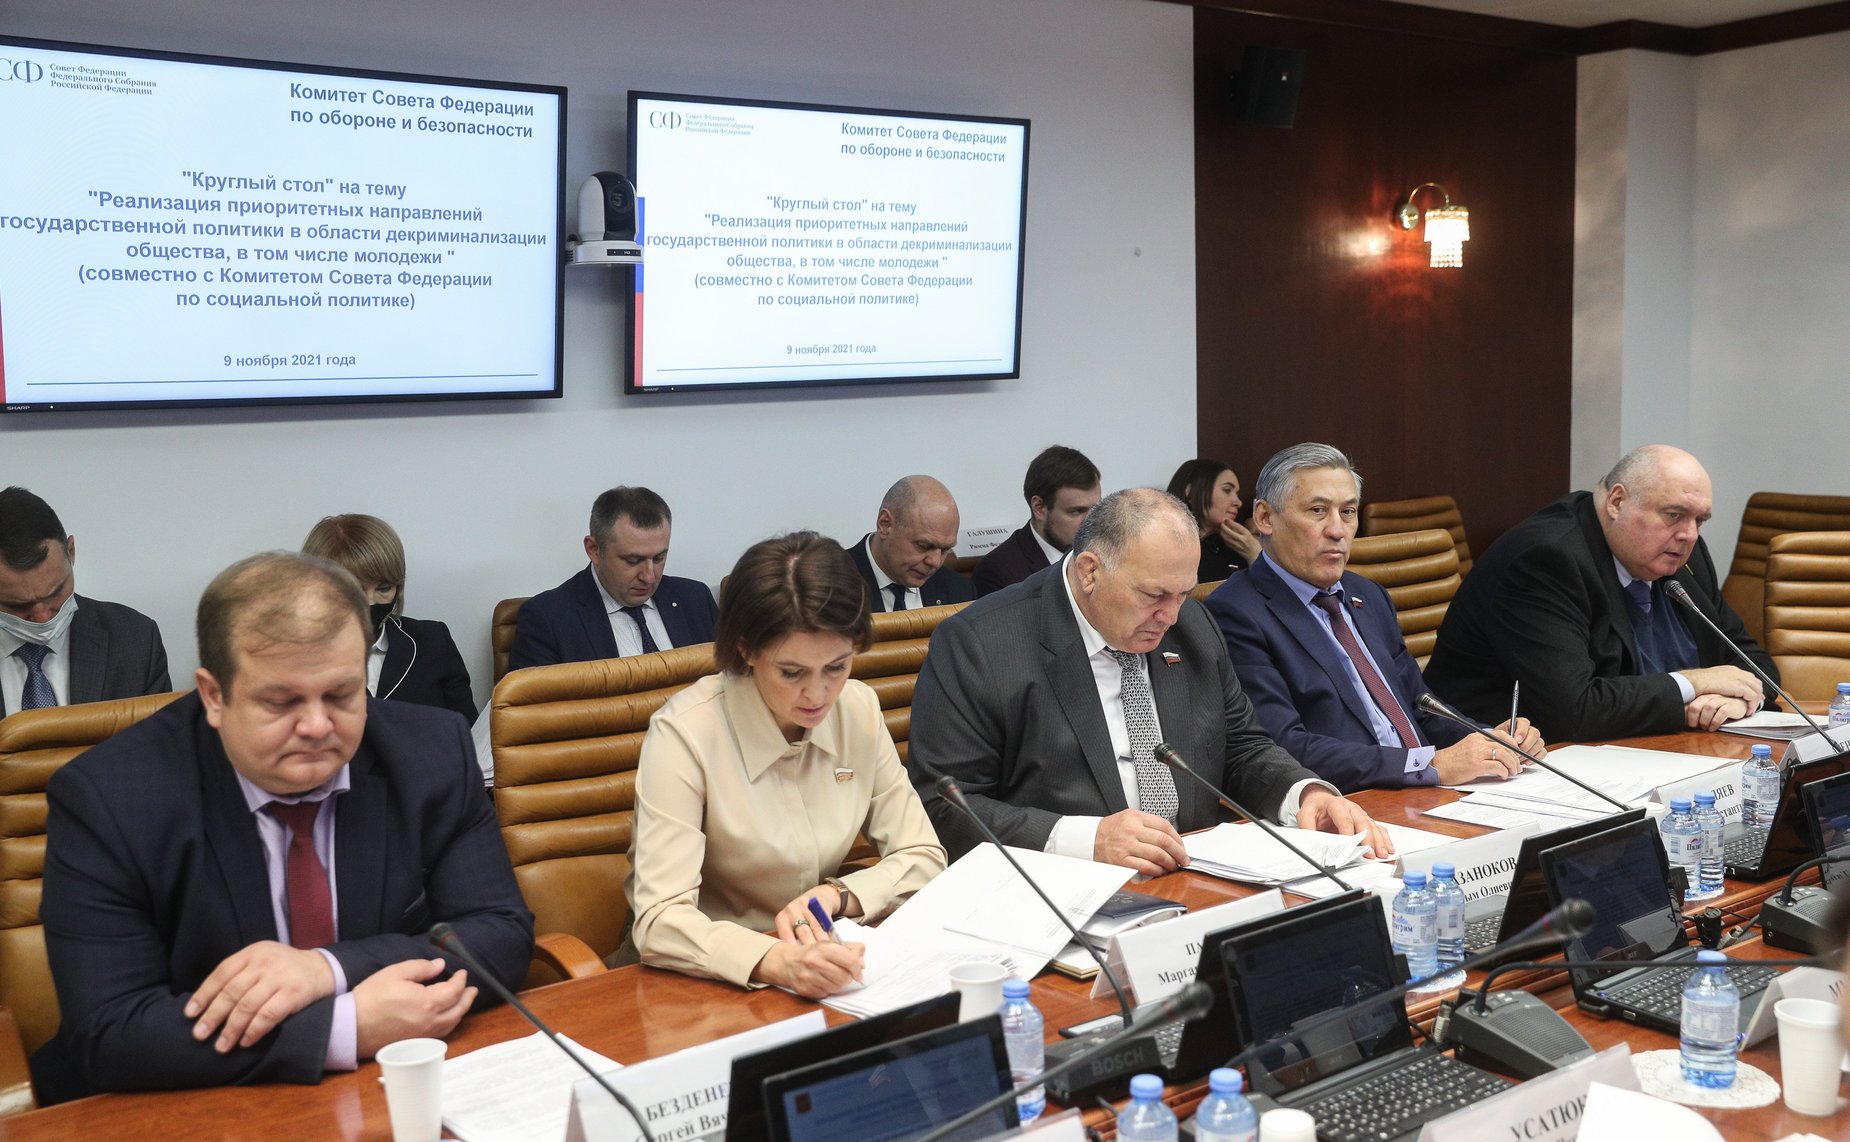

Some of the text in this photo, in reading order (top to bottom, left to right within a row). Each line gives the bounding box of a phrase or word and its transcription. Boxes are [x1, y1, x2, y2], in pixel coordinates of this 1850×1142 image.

[50, 63, 127, 77] Совет Федерации
[50, 71, 157, 88] Федерального Собрания
[50, 79, 152, 95] Российской Федерации
[291, 83, 533, 117] Комитет Совета Федерации
[291, 110, 533, 138] по обороне и безопасности
[649, 110, 682, 129] СФ
[842, 122, 1006, 145] Комитет Совета Федерации
[841, 143, 1004, 162] по обороне и безопасности
[183, 171, 406, 200] "Круглый стол" на тему
[88, 190, 482, 222] "Реализация приоритетных направлений
[767, 196, 916, 216] "Круглый стол" на тему
[1, 216, 546, 246] государственной политики в области декриминализации
[705, 214, 967, 234] "Реализация приоритетных направлений
[647, 235, 1011, 252] государственной политики в области декриминализации
[126, 242, 230, 262] общества,
[237, 248, 248, 259] в
[254, 249, 288, 260] том
[295, 250, 348, 262] числе
[355, 251, 441, 266] молодежи
[727, 254, 795, 268] общества,
[800, 258, 807, 267] в
[812, 258, 834, 267] том
[839, 258, 875, 268] числе
[879, 259, 938, 269] молодежи
[79, 265, 491, 289] (совместно с Комитетом Совета Федерации
[695, 273, 972, 288] (совместно с Комитетом Совета Федерации
[177, 292, 415, 310] по социальной политике)
[758, 293, 918, 307] по социальной политике)
[787, 344, 877, 356] 9 ноября 2021 года
[223, 354, 356, 369] 9 ноября 2021 года
[967, 528, 1008, 537] ГАЛУШИНА
[1091, 1048, 1144, 1077] BOSCH
